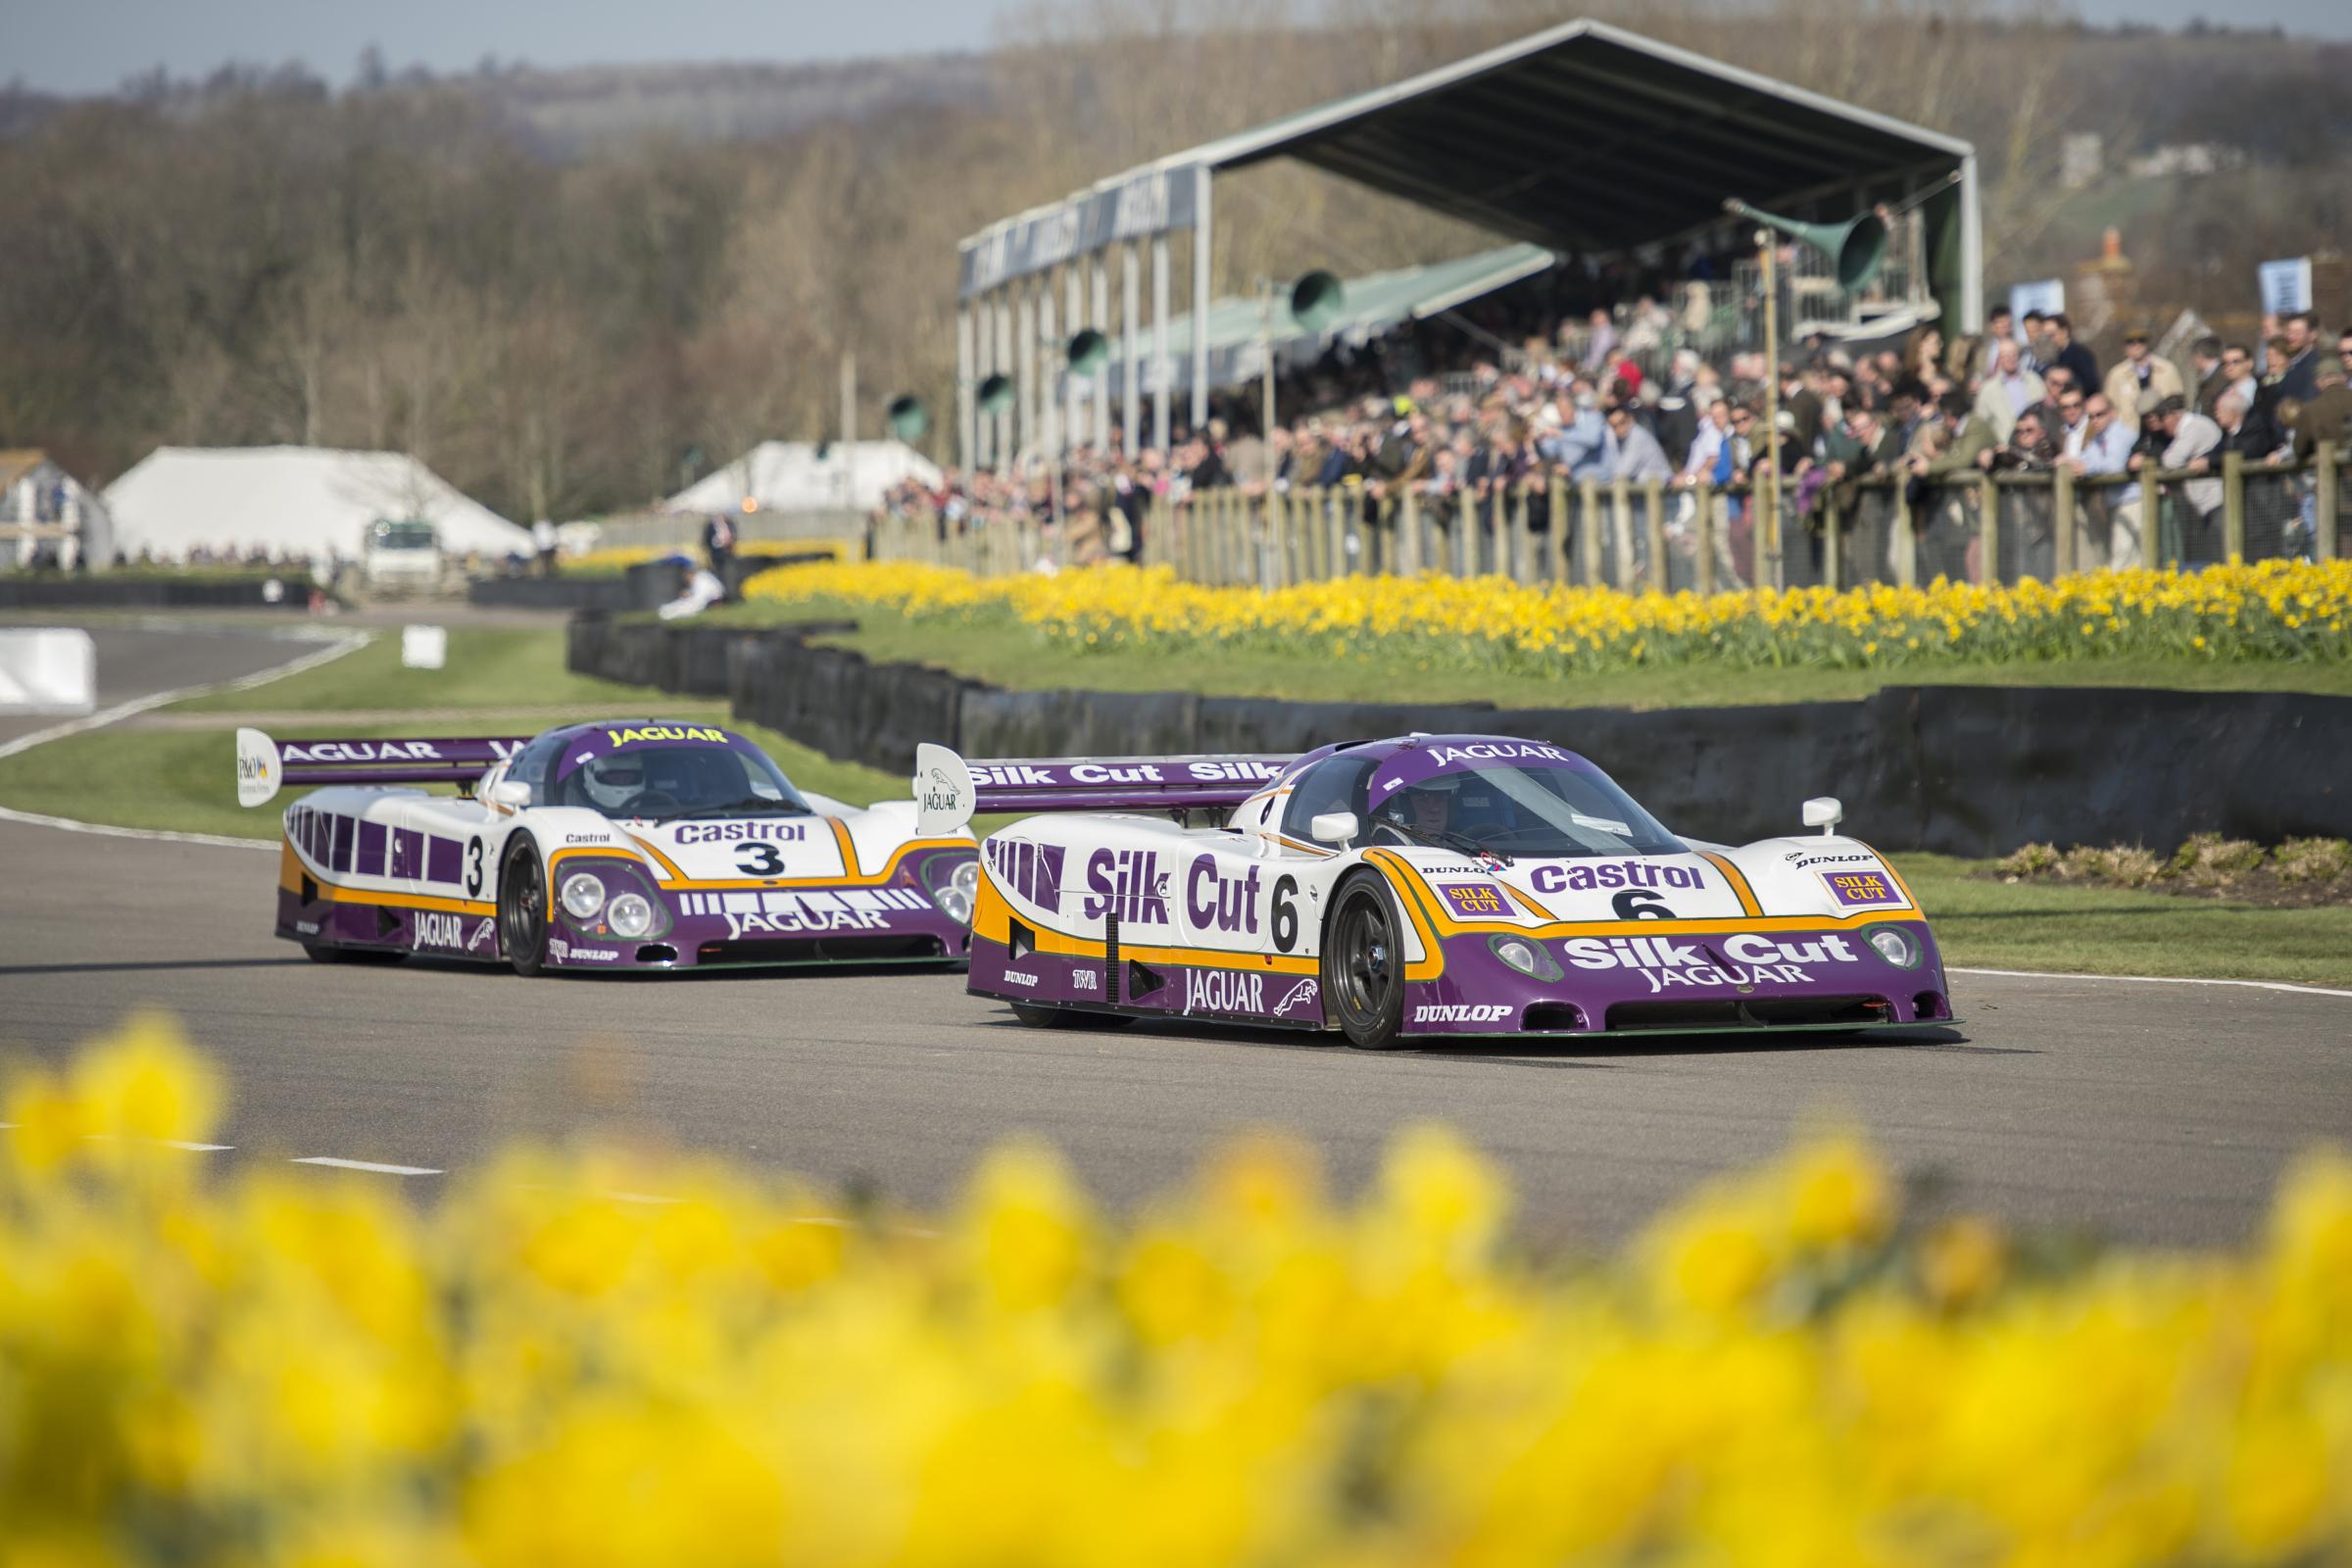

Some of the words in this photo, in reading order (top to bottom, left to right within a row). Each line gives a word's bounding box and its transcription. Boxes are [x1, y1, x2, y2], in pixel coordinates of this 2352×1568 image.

[608, 727, 729, 748] JAGUAR
[282, 742, 442, 761] AGUAR
[1427, 744, 1569, 767] JAGUAR
[967, 765, 1057, 786] Silk
[1069, 764, 1164, 783] Cut
[1188, 761, 1282, 781] Silk
[923, 793, 956, 812] JAGUAR
[565, 833, 611, 844] Castrol
[674, 821, 806, 845] Castrol
[466, 835, 483, 898] 3
[734, 842, 786, 876] 3
[1795, 855, 1874, 870] DUNLOP
[1530, 860, 1705, 894] Castrol
[1834, 875, 1885, 888] SILK
[1084, 847, 1171, 924] Silk
[1187, 853, 1261, 934] Cut
[1448, 887, 1498, 900] SILK
[1845, 887, 1887, 901] CUT
[1270, 873, 1299, 954] 6
[1460, 899, 1501, 911] CUT
[413, 910, 463, 952] JAGUAR
[723, 909, 892, 941] JAGUAR
[1563, 937, 1709, 970] Silk
[1723, 933, 1859, 965] Cut
[1004, 969, 1039, 988] DUNLOP
[1072, 969, 1098, 991] TWR
[1638, 964, 1816, 994] JAGUAR
[1182, 967, 1265, 1016] JAGUAR
[1413, 1004, 1514, 1022] DUNLOP
